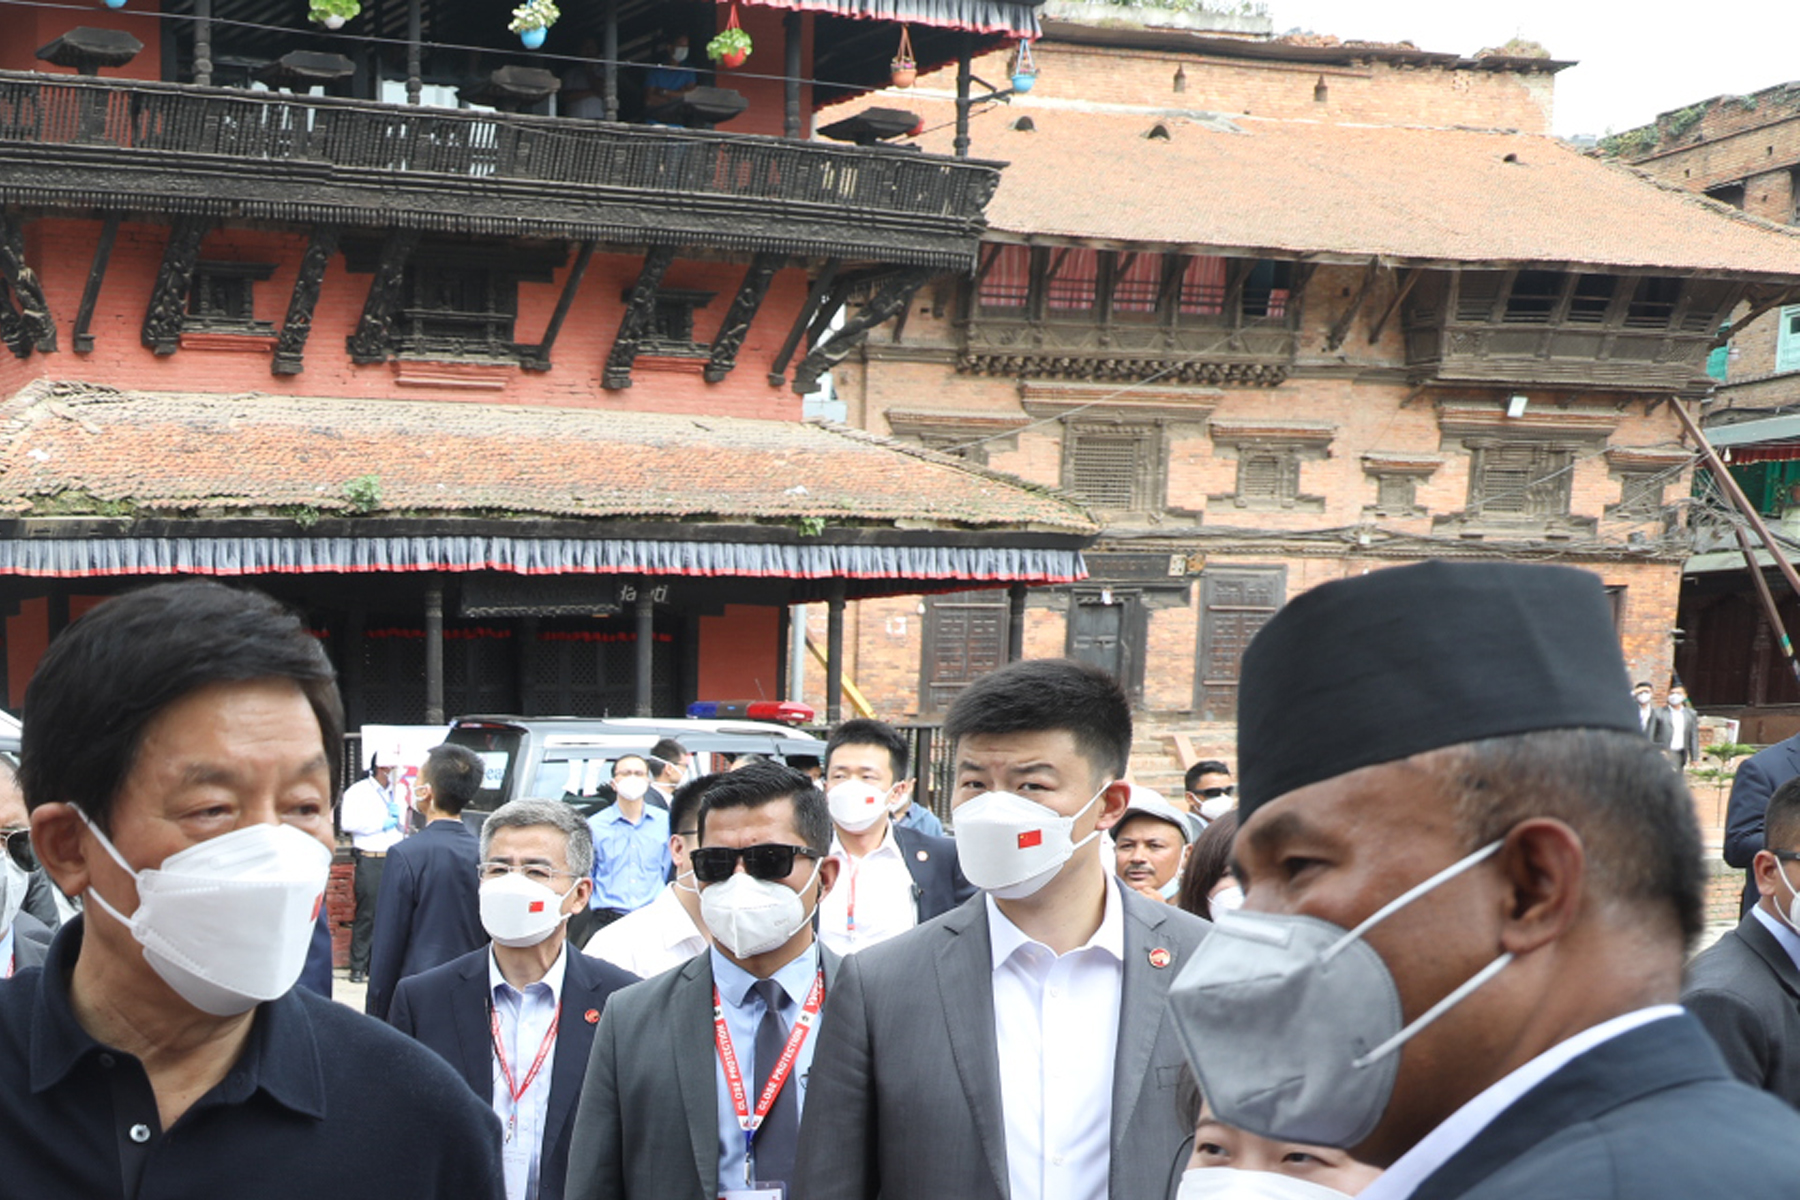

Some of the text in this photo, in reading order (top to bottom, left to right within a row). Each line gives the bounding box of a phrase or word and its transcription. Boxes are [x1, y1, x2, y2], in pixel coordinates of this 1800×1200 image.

[715, 1023, 747, 1111] CLOSE PROTECTION
[758, 1027, 804, 1110] CLOSE PROTECTION
